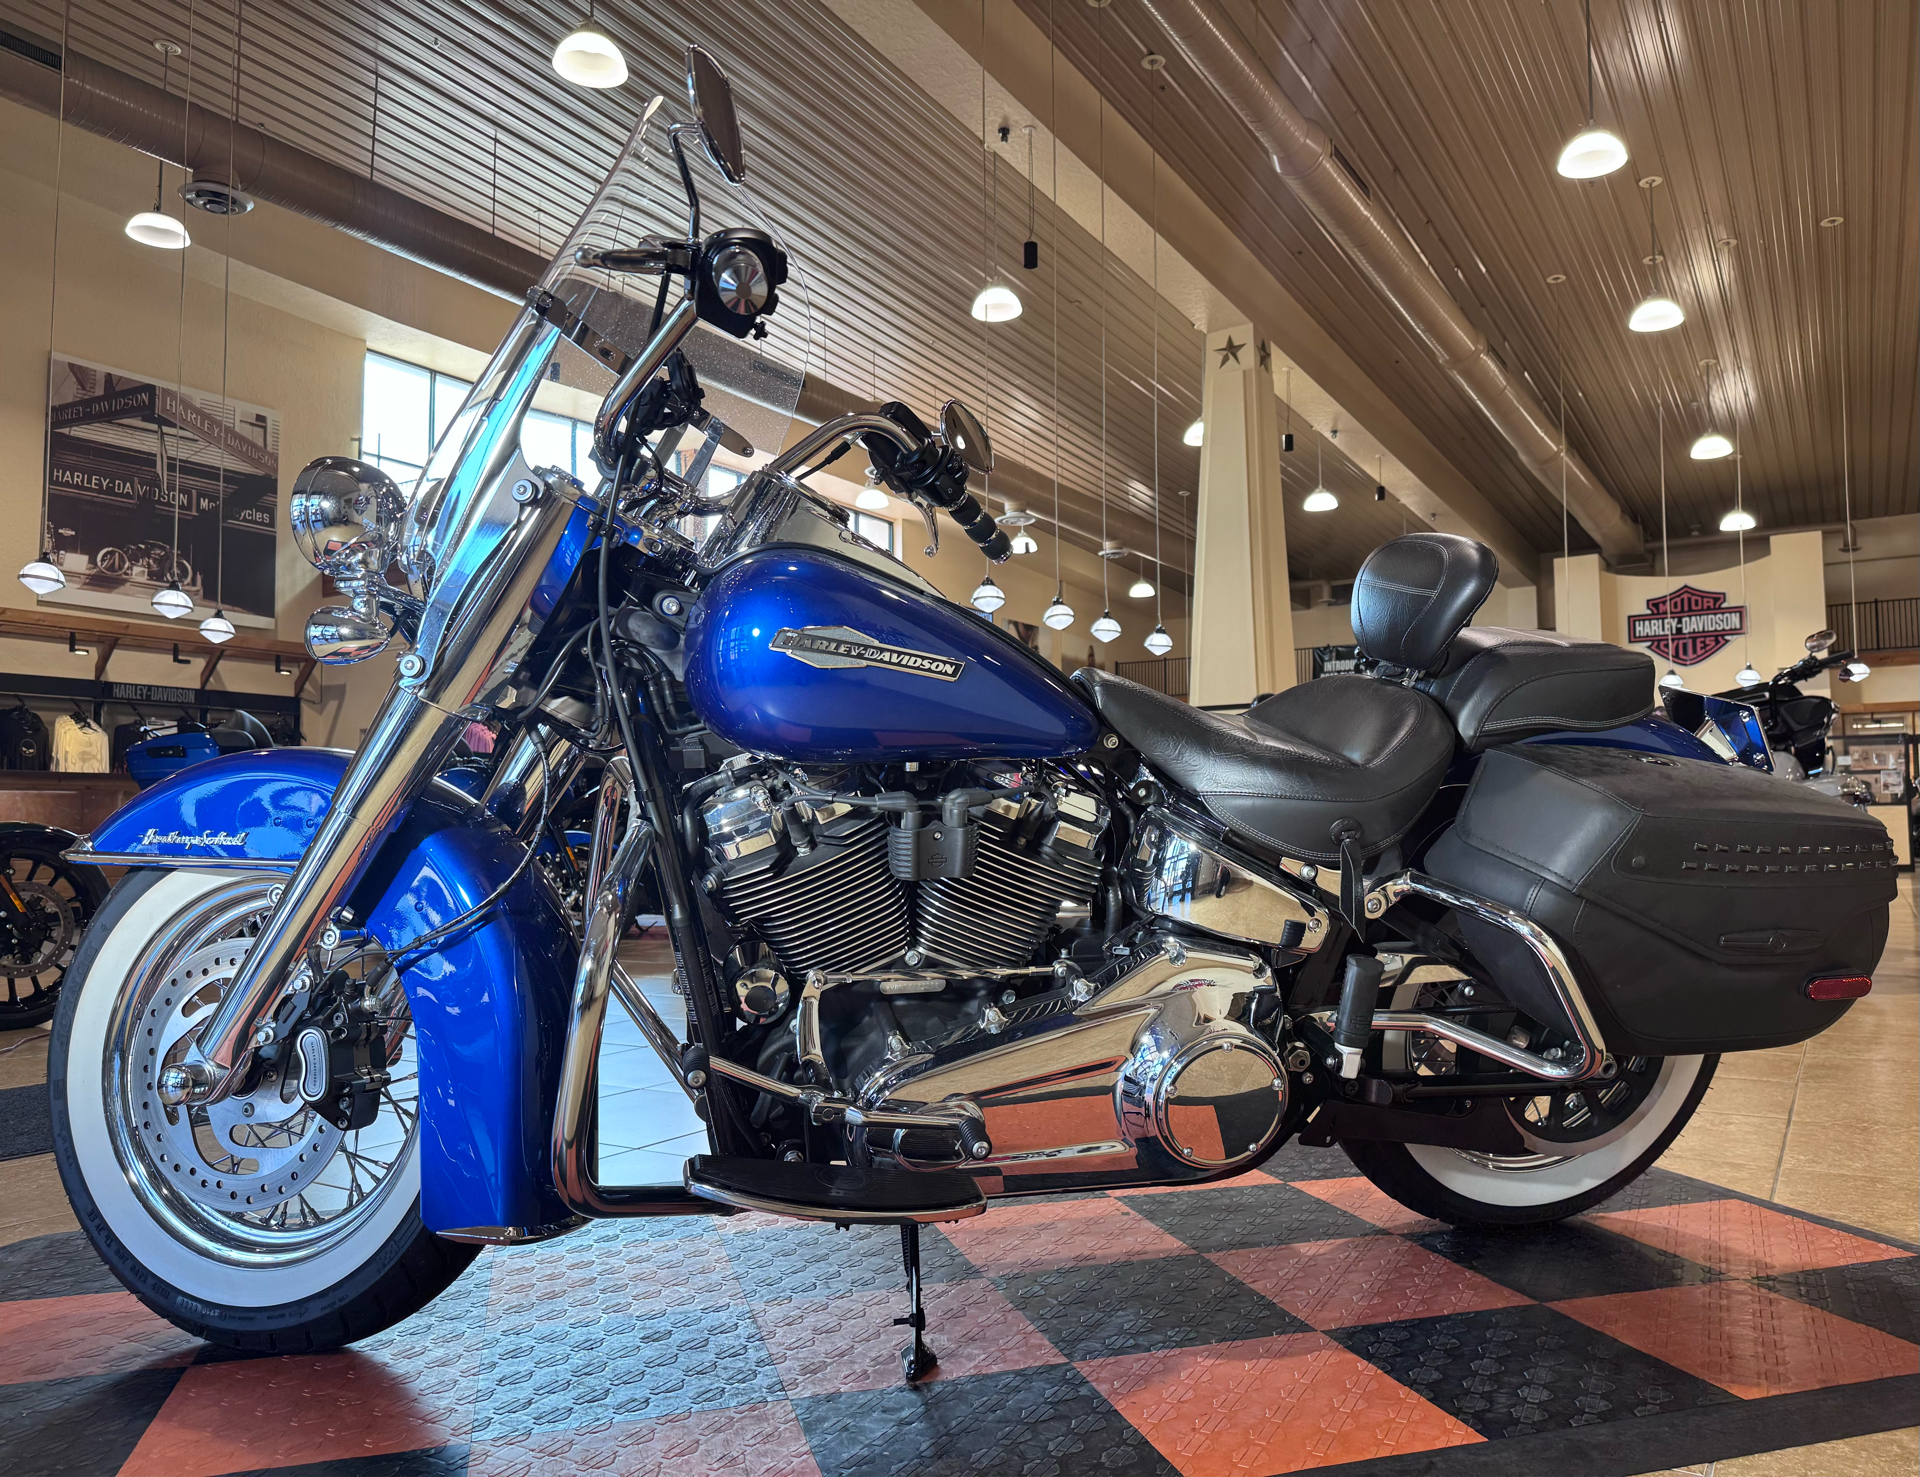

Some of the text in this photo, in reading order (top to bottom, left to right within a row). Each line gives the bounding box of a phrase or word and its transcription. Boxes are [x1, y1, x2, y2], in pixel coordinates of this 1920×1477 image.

[166, 396, 277, 470] HARLEY-DAVIDSON
[1658, 593, 1714, 614] MOTOR
[1635, 612, 1740, 637] HARLEY-DAVIDSON
[783, 634, 955, 675] HARLEY-DAVIDSON
[1660, 636, 1716, 660] CYCLES
[113, 683, 195, 704] HARLEY-DAVIDSON
